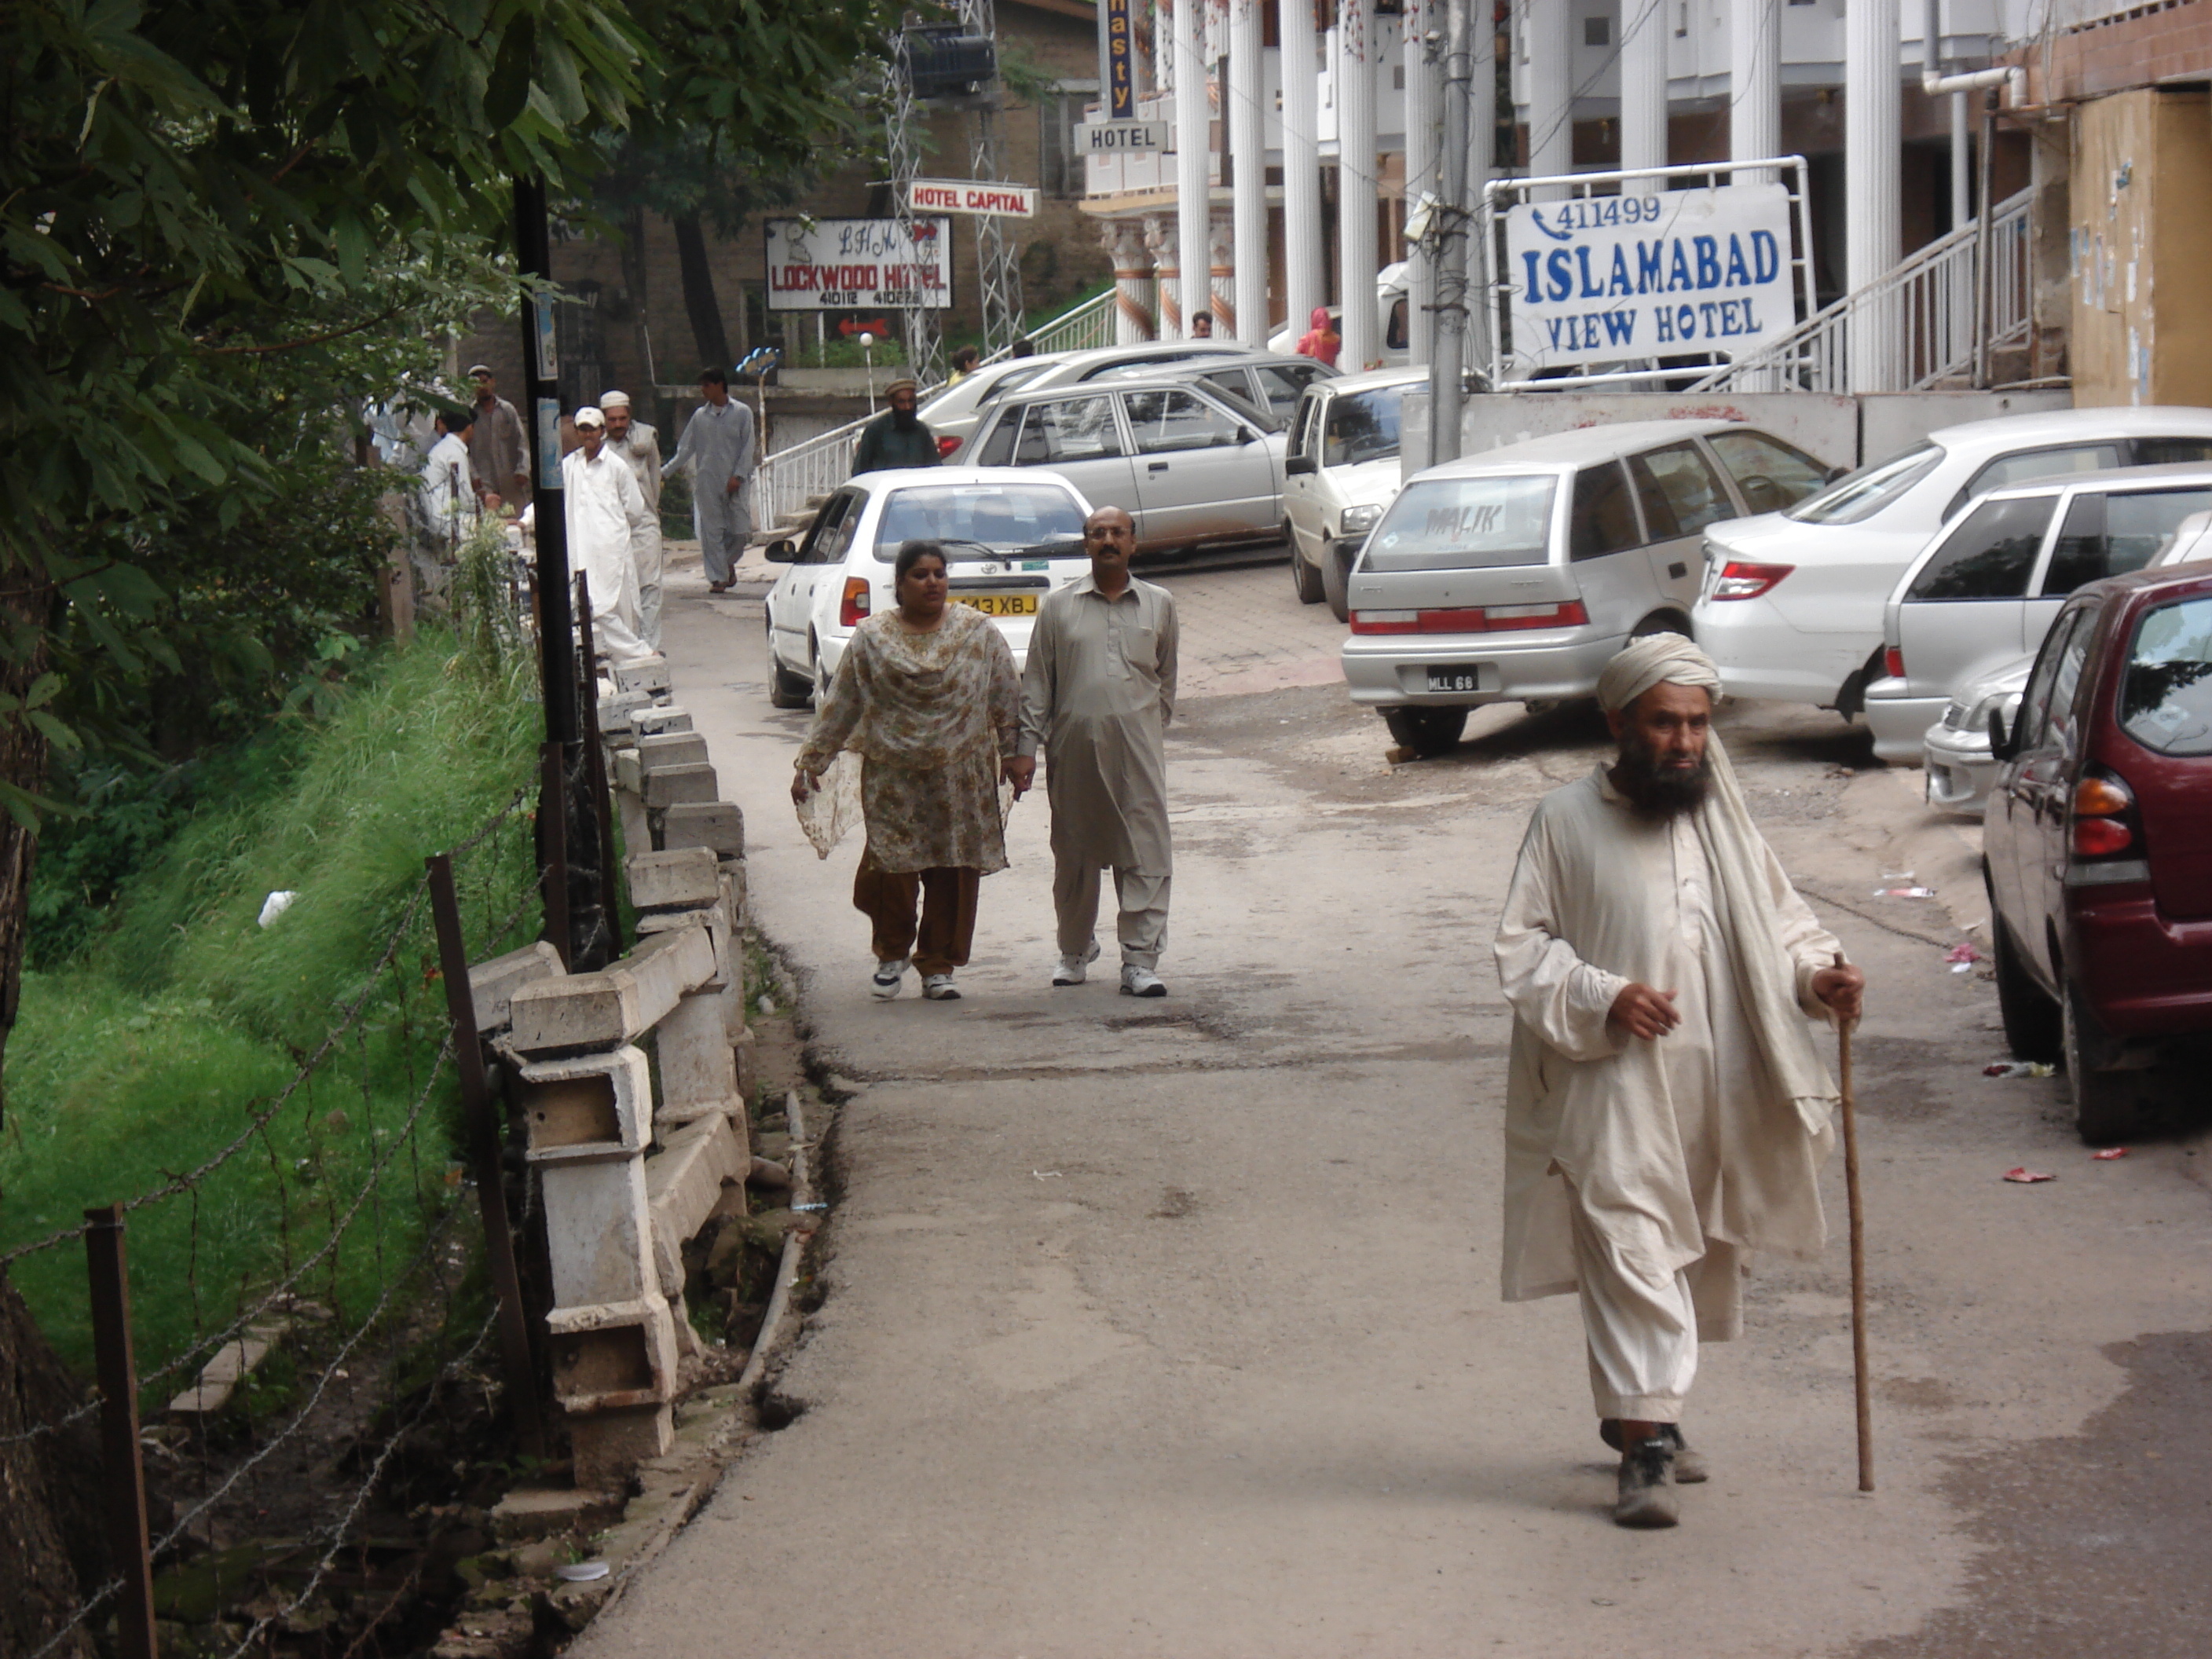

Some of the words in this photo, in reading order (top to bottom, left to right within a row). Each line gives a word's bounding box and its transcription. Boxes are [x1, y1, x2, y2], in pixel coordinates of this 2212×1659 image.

[1091, 127, 1155, 148] HOTEL
[914, 187, 961, 207] HOTEL
[967, 190, 1028, 213] CAPITAL
[1557, 197, 1661, 229] 411499
[771, 264, 878, 291] LOCKWOOD
[1522, 229, 1779, 303] ISLAMABAD
[1546, 309, 1637, 352] VIEW
[1654, 297, 1763, 342] HOTEL
[1426, 504, 1503, 536] MALIK
[1000, 596, 1037, 614] XBJ
[1428, 676, 1452, 690] MLL
